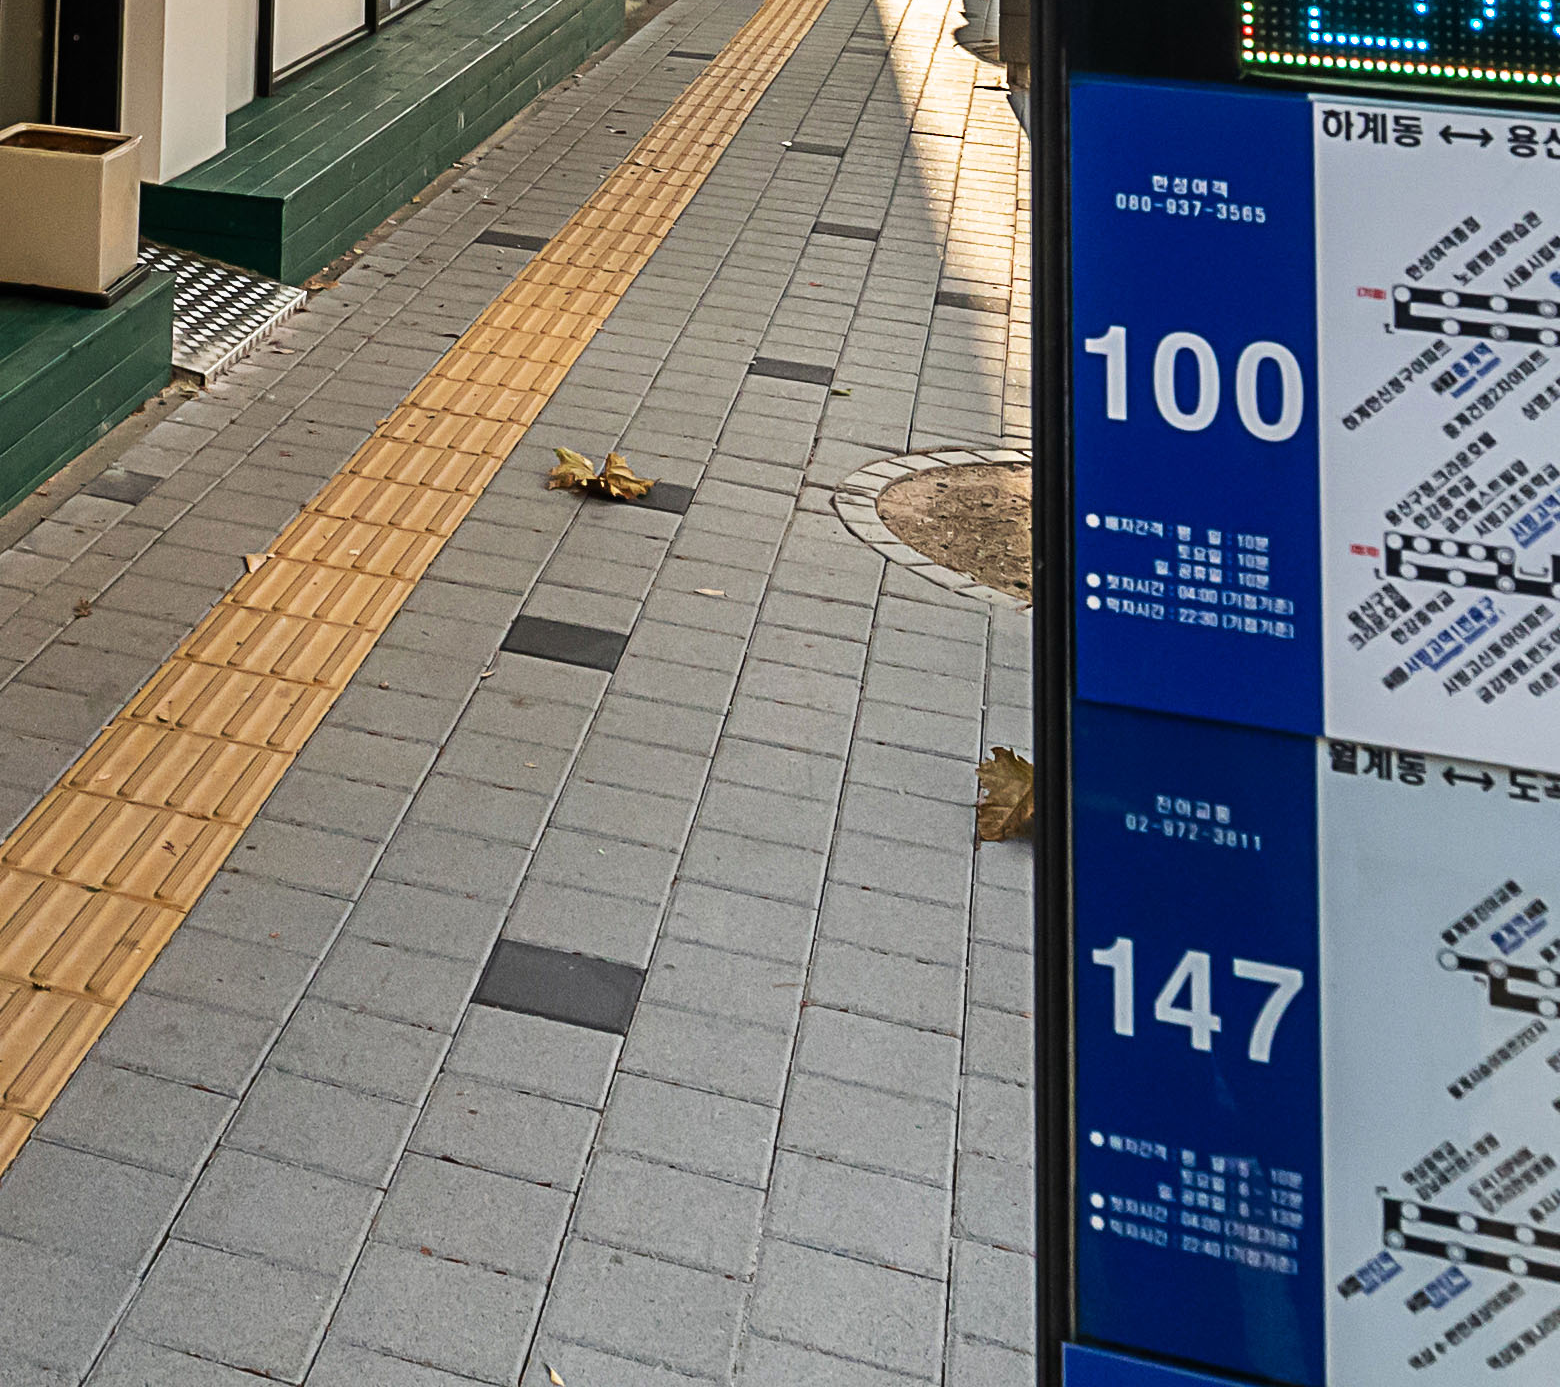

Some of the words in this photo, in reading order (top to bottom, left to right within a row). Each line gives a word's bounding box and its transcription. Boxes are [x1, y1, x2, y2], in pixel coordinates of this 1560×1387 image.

[1320, 107, 1424, 148] 하계동
[1151, 173, 1230, 199] 한성여객
[1114, 193, 1268, 225] 080-937-3565
[1083, 323, 1306, 444] 100
[1326, 739, 1428, 785] 월계동
[1124, 815, 1264, 852] 02-972-3811
[1090, 934, 1306, 1065] 147
